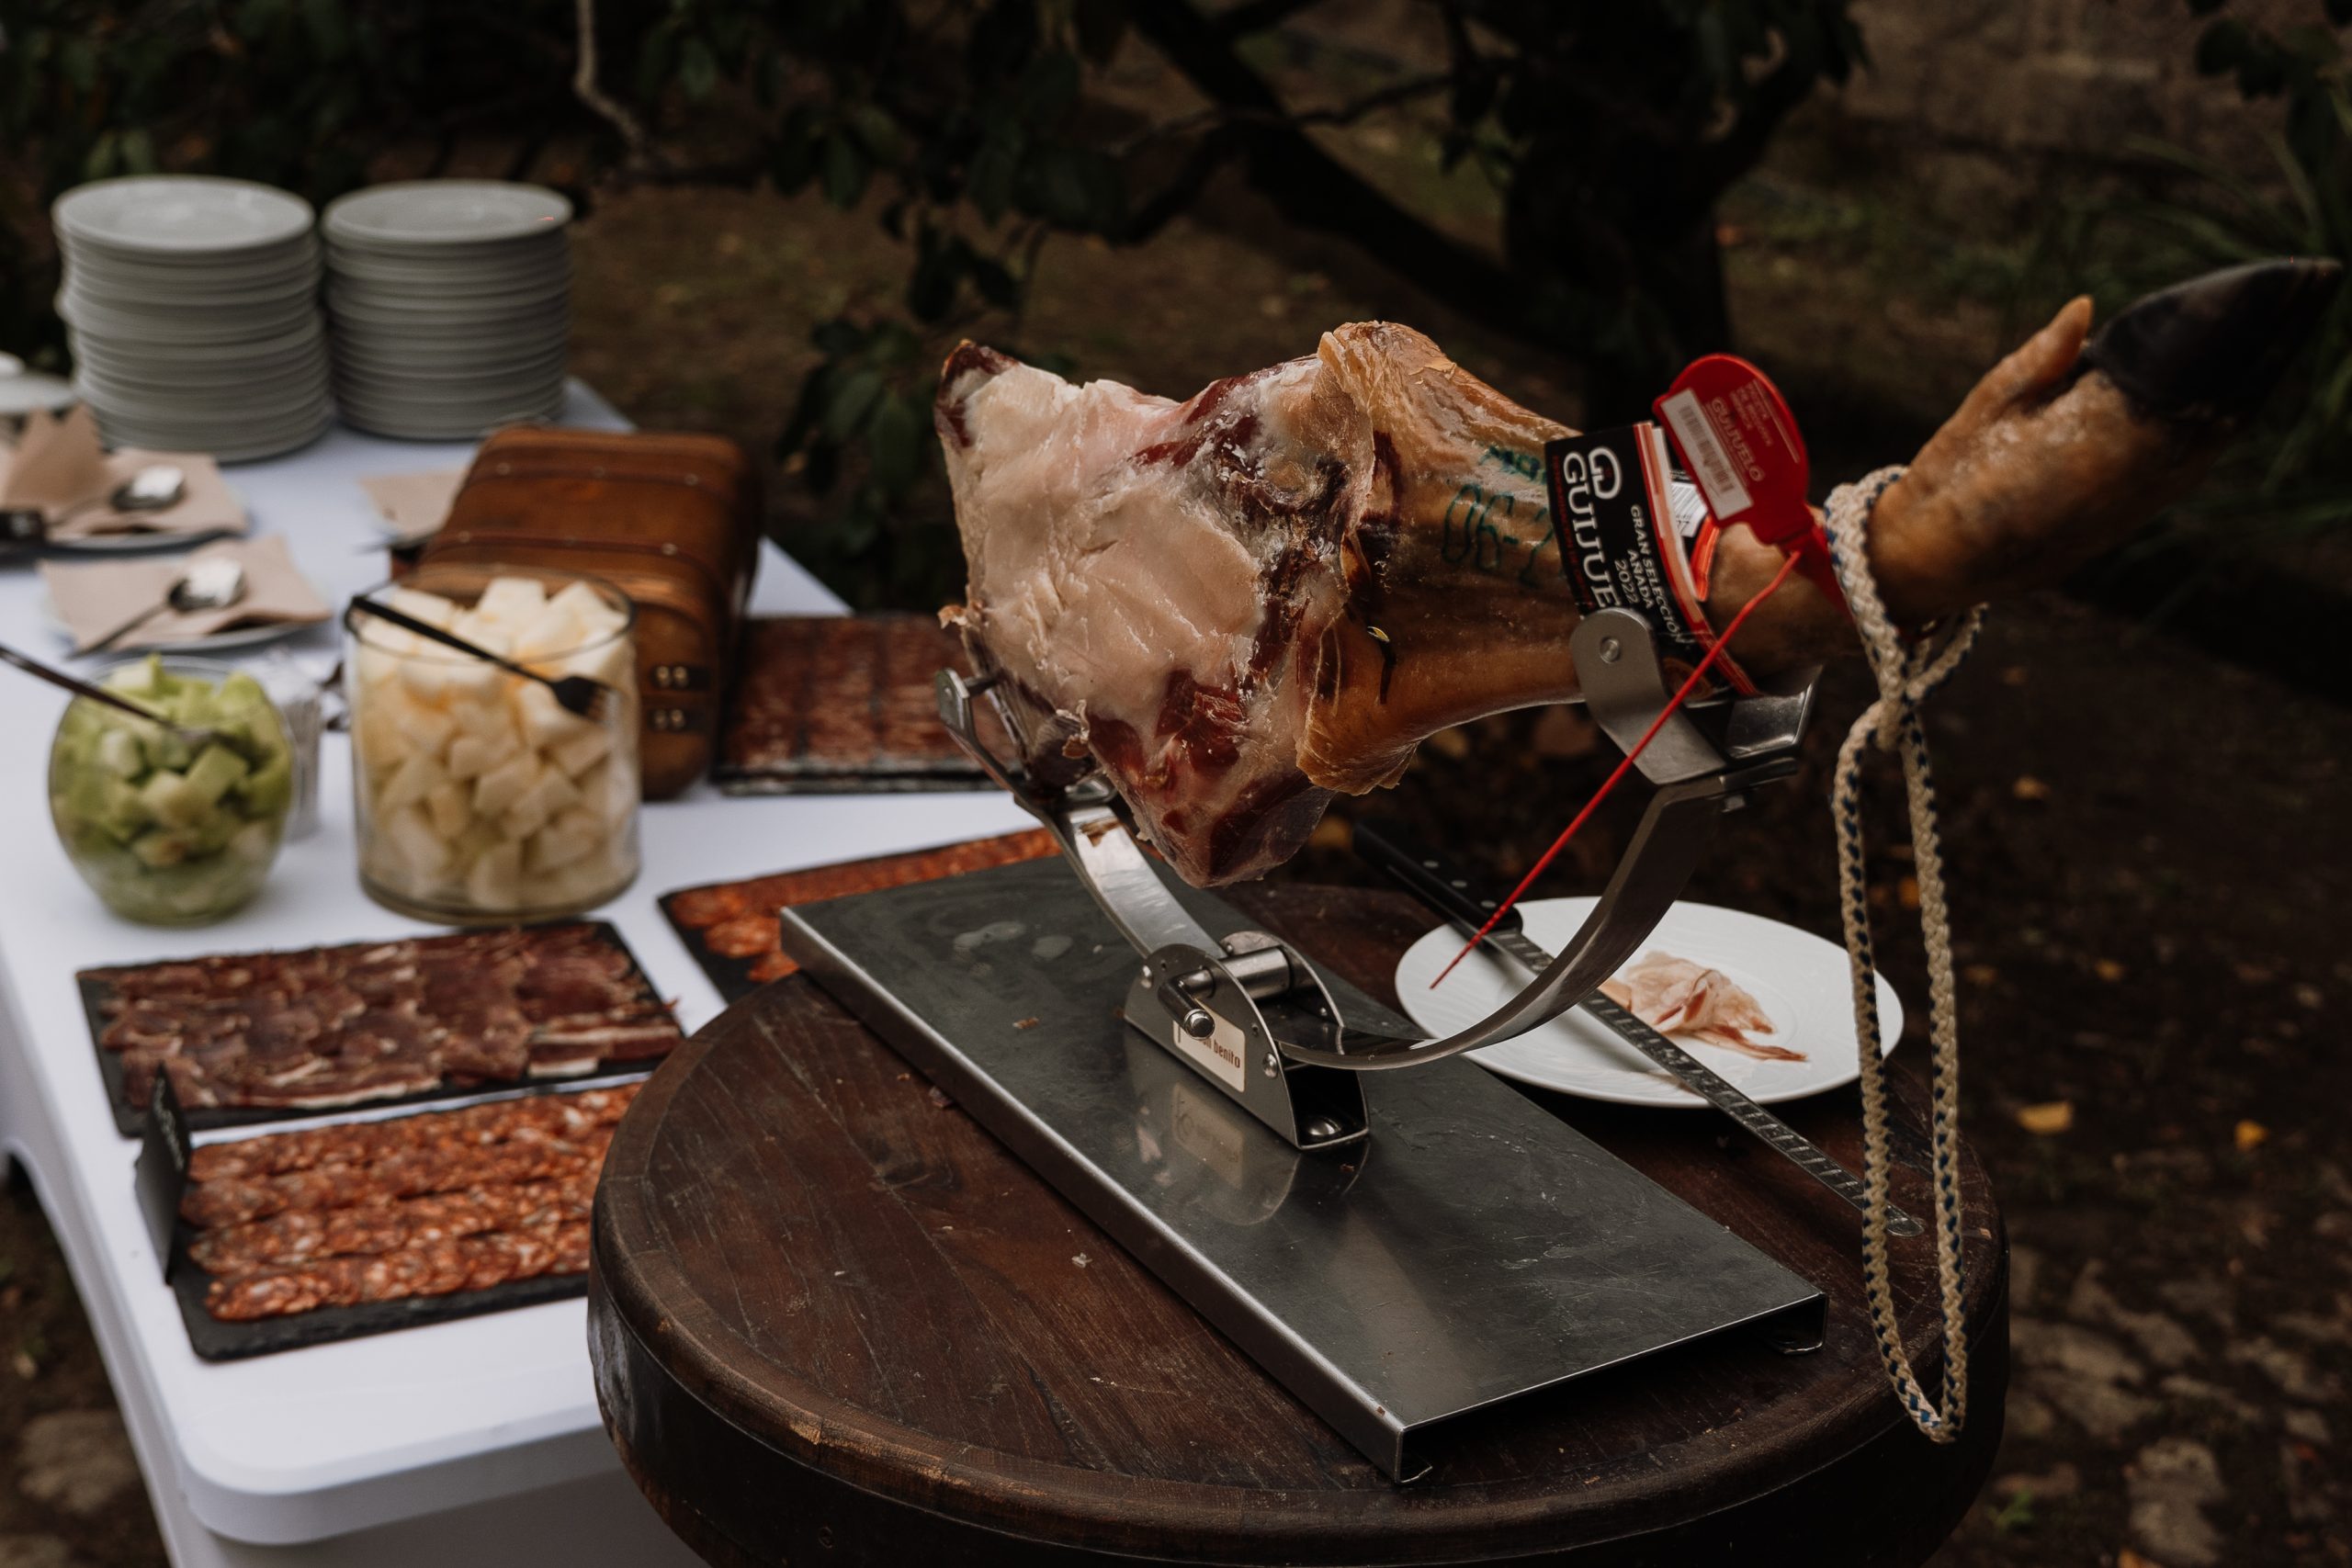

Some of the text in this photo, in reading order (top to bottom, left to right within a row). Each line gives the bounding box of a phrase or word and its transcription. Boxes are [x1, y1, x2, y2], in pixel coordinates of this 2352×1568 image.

[1712, 396, 1765, 481] GUIJUELO
[1563, 451, 1622, 608] GUIJUE
[1631, 504, 1650, 555] GRAN
[1614, 559, 1639, 604] 2022
[1627, 549, 1653, 609] AÑADA
[1213, 1039, 1240, 1068] benito
